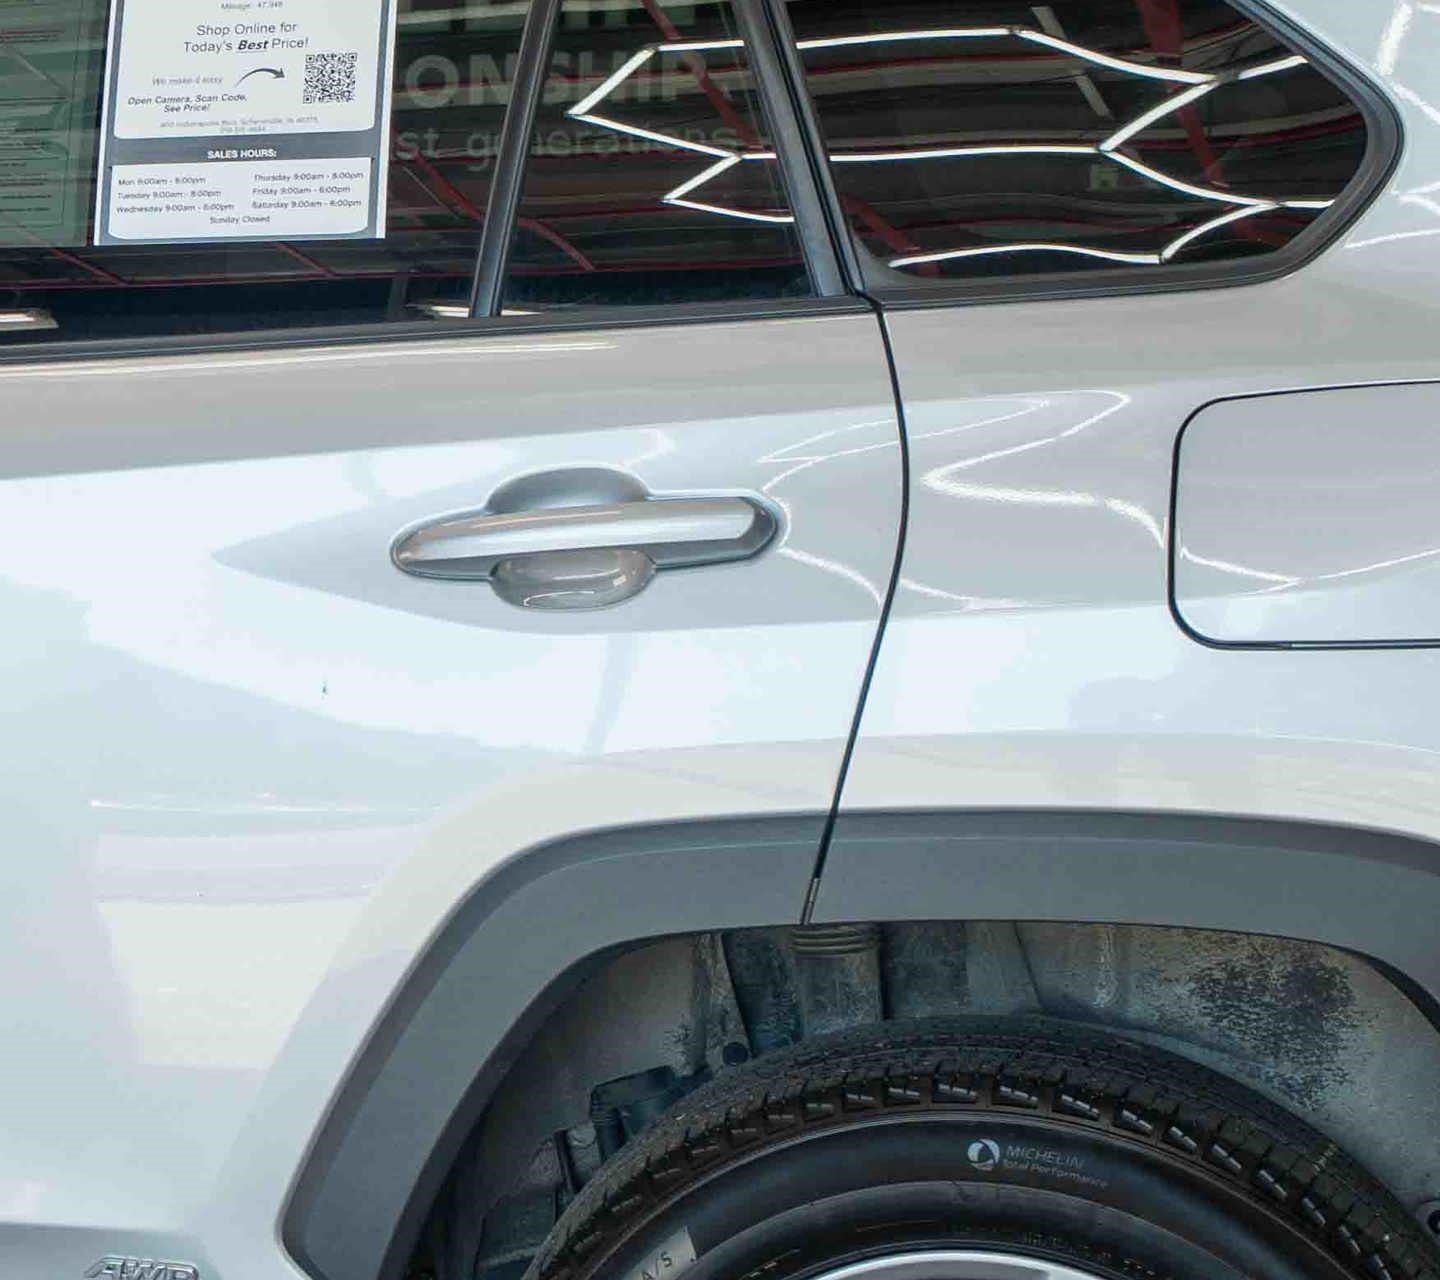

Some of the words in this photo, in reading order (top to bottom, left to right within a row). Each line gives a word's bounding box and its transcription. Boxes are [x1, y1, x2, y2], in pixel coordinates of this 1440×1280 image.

[196, 24, 230, 39] Shop
[234, 22, 276, 35] Online
[280, 21, 298, 33] for
[184, 39, 233, 55] Today's
[236, 39, 269, 52] Best
[271, 37, 309, 49] Price!
[127, 95, 152, 107] Open
[155, 94, 192, 106] Camera,
[195, 93, 219, 103] Scan
[221, 92, 248, 103] Code,
[163, 103, 182, 113] See
[183, 102, 211, 113] Price!
[207, 149, 239, 160] SALES
[240, 148, 277, 159] HOURS:
[118, 178, 136, 186] Mon
[254, 173, 291, 183] Thursday
[118, 191, 150, 200] Tuesday
[252, 187, 278, 197] Friday
[117, 205, 162, 214] Wednesday
[252, 201, 289, 211] Saturday
[209, 216, 239, 225] Sunday
[241, 215, 270, 224] Closed
[1005, 1145, 1085, 1170] MICHELIN
[1030, 1163, 1110, 1189] Performance
